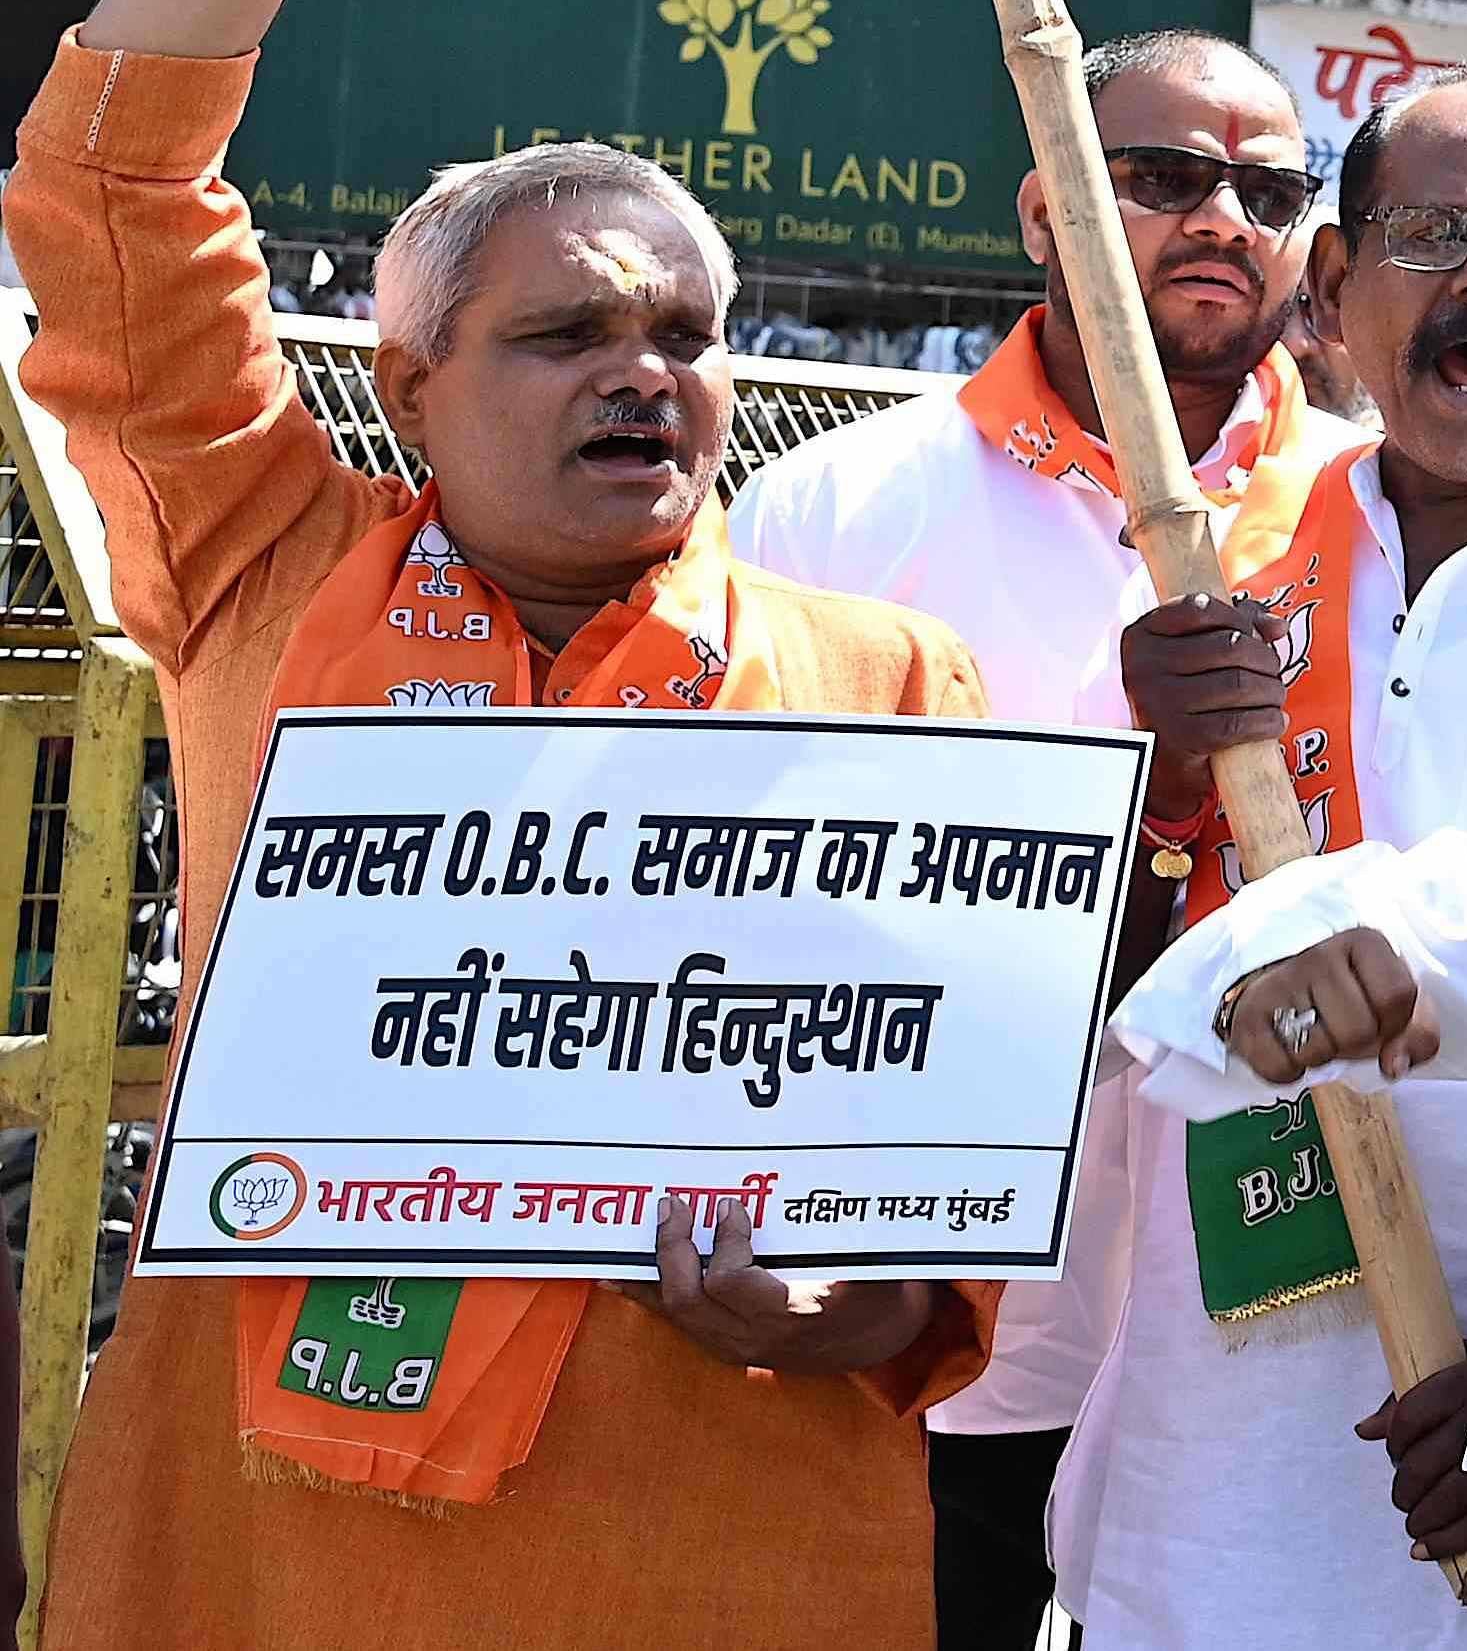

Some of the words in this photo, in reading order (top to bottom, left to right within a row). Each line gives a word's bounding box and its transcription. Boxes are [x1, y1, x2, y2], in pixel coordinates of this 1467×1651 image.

[800, 148, 967, 210] LAND
[775, 212, 855, 243] Dadar
[252, 812, 444, 900] समस्त
[442, 808, 609, 901] O.B.C.
[631, 813, 804, 899] समाज
[815, 818, 900, 903] का
[899, 821, 1113, 917] अपमान
[369, 947, 503, 1071] नहीं
[492, 948, 658, 1072] सहेगा
[660, 952, 944, 1110] हिन्दुस्थान
[316, 1163, 497, 1226] भारतीय
[511, 1179, 655, 1226] जनता
[783, 1189, 871, 1225] दक्षिण
[877, 1195, 940, 1222] मध्य
[945, 1188, 1016, 1233] मुंबई
[1236, 1144, 1336, 1226] B.J.
